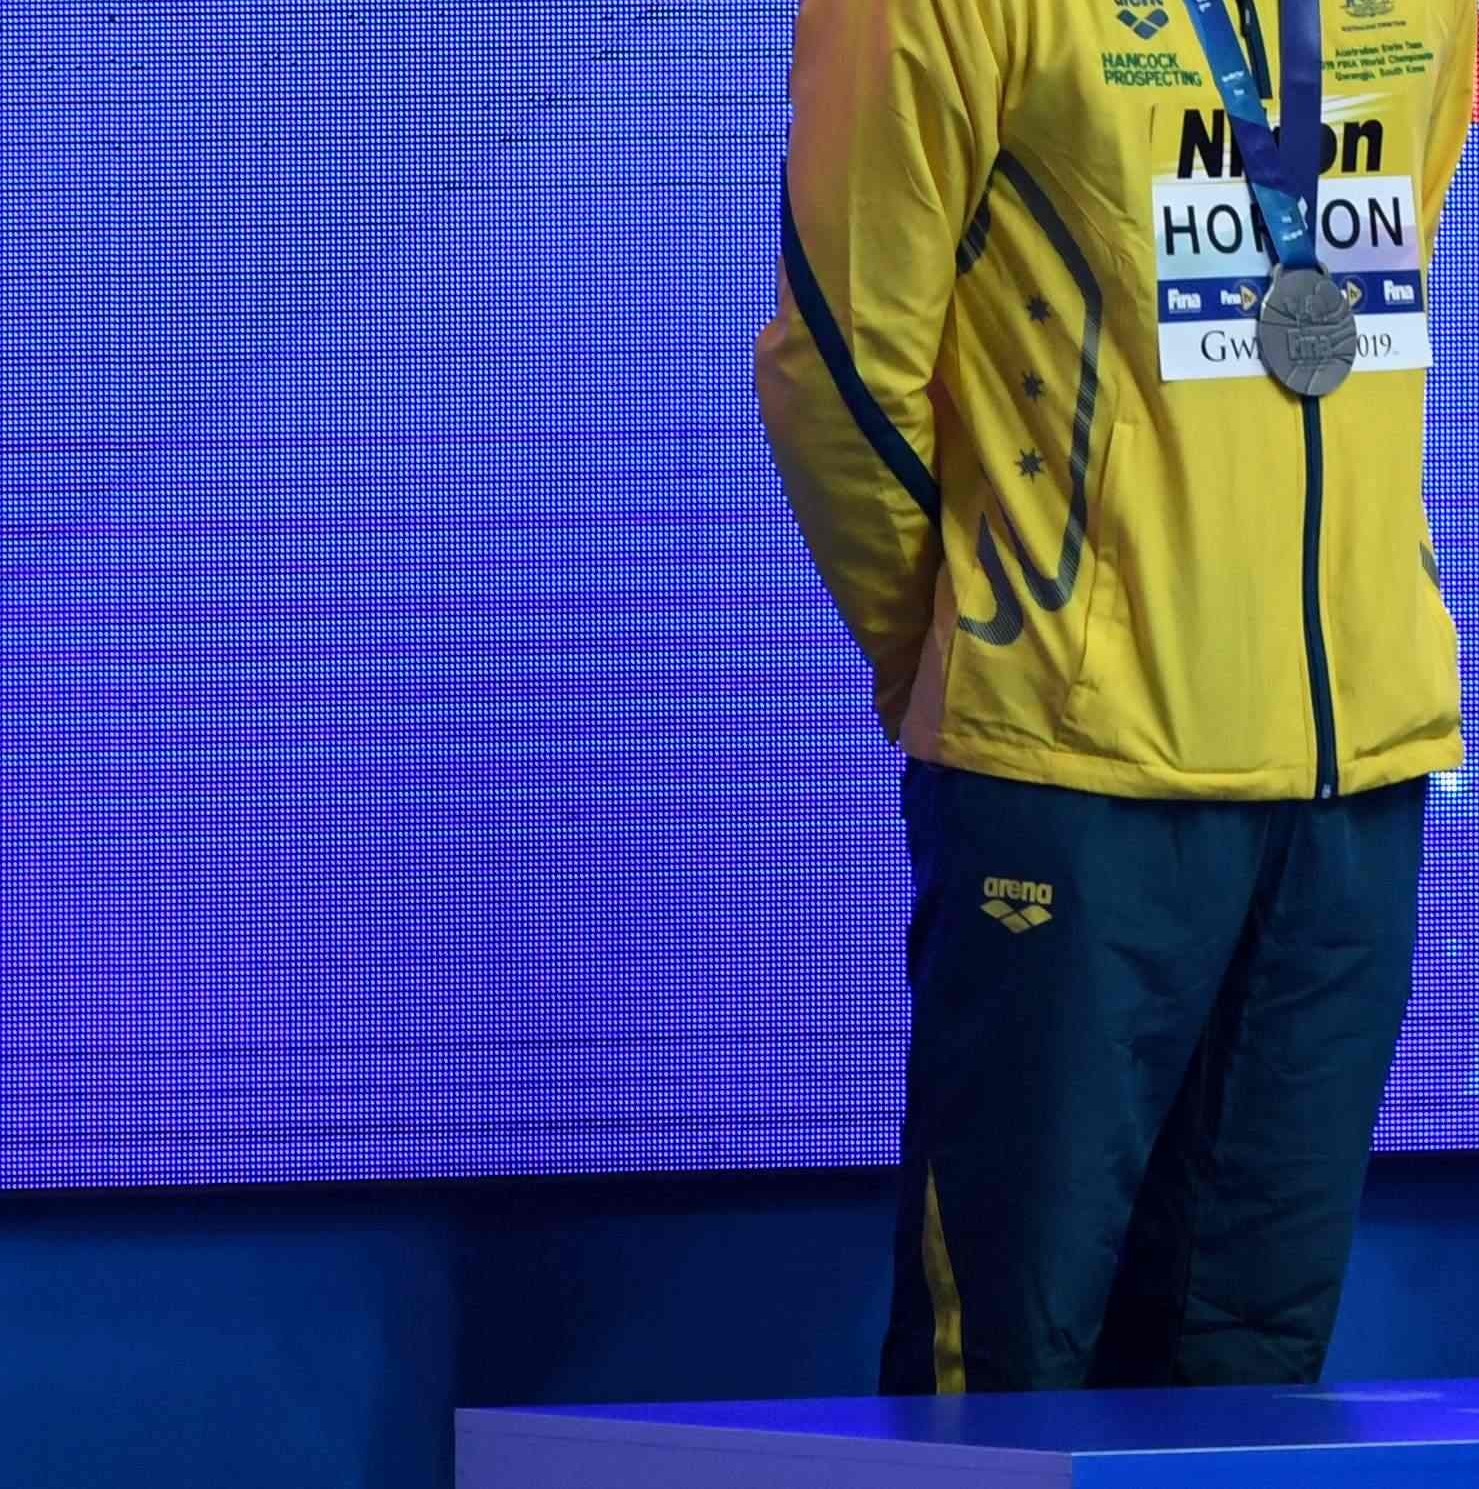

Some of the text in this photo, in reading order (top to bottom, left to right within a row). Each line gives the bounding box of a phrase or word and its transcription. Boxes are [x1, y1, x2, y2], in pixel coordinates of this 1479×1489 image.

[1101, 52, 1179, 69] HANCOCK
[1103, 69, 1203, 88] PROSPECTING
[1166, 287, 1202, 312] Fina
[1383, 279, 1416, 303] Fina
[1356, 332, 1393, 359] 019
[983, 876, 1053, 905] arena
